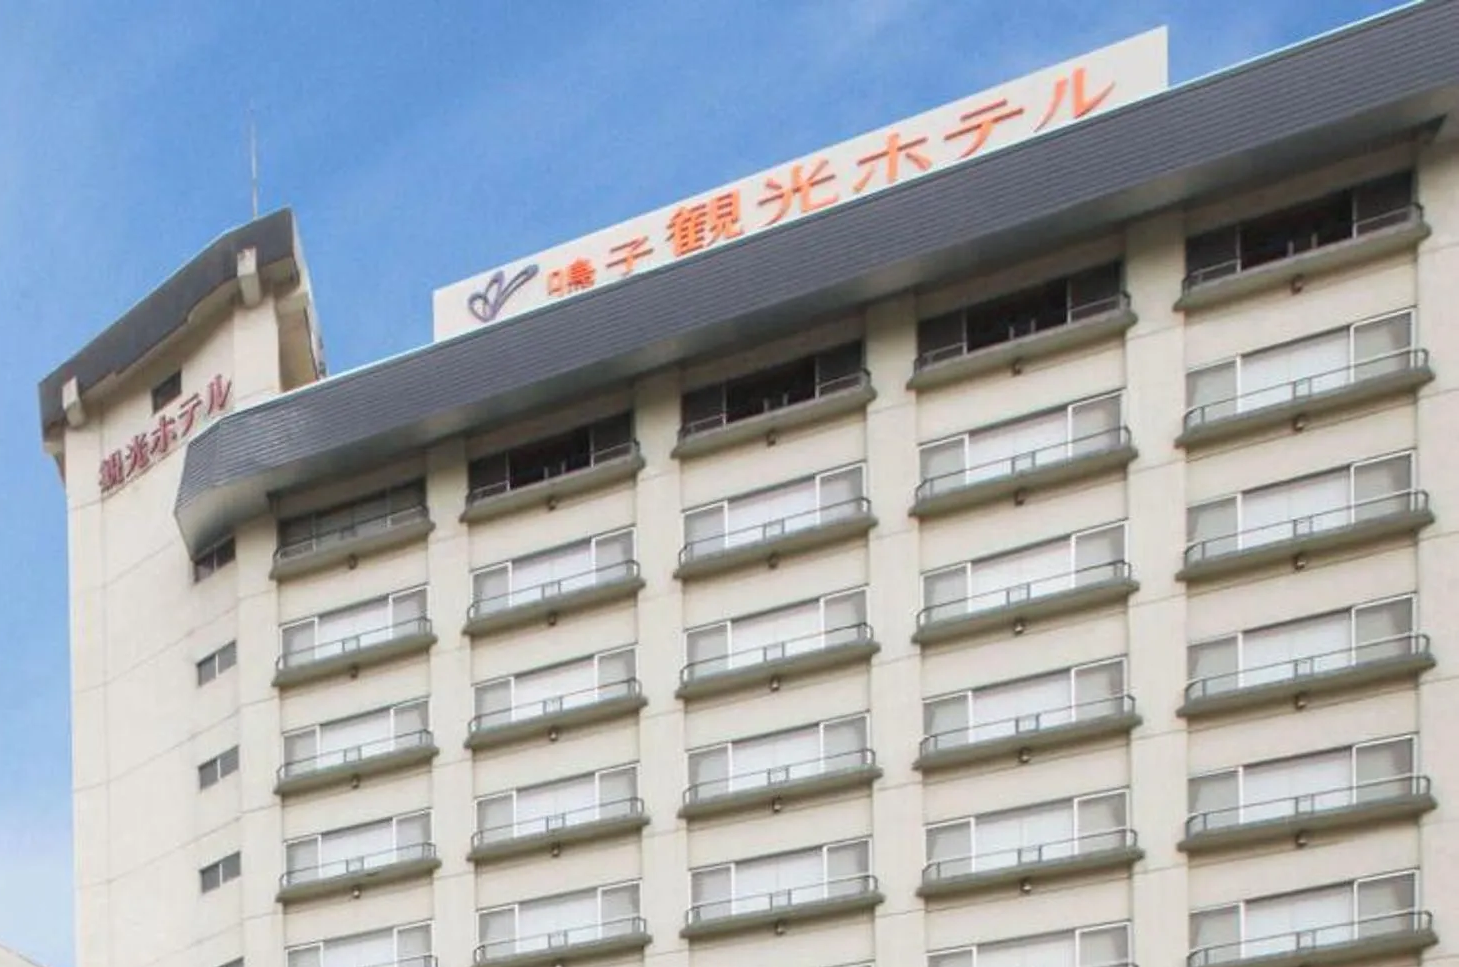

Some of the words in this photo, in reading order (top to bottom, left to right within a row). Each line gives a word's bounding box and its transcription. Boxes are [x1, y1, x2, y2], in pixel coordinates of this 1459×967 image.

[546, 67, 1115, 297] 鳴子観光ホテル
